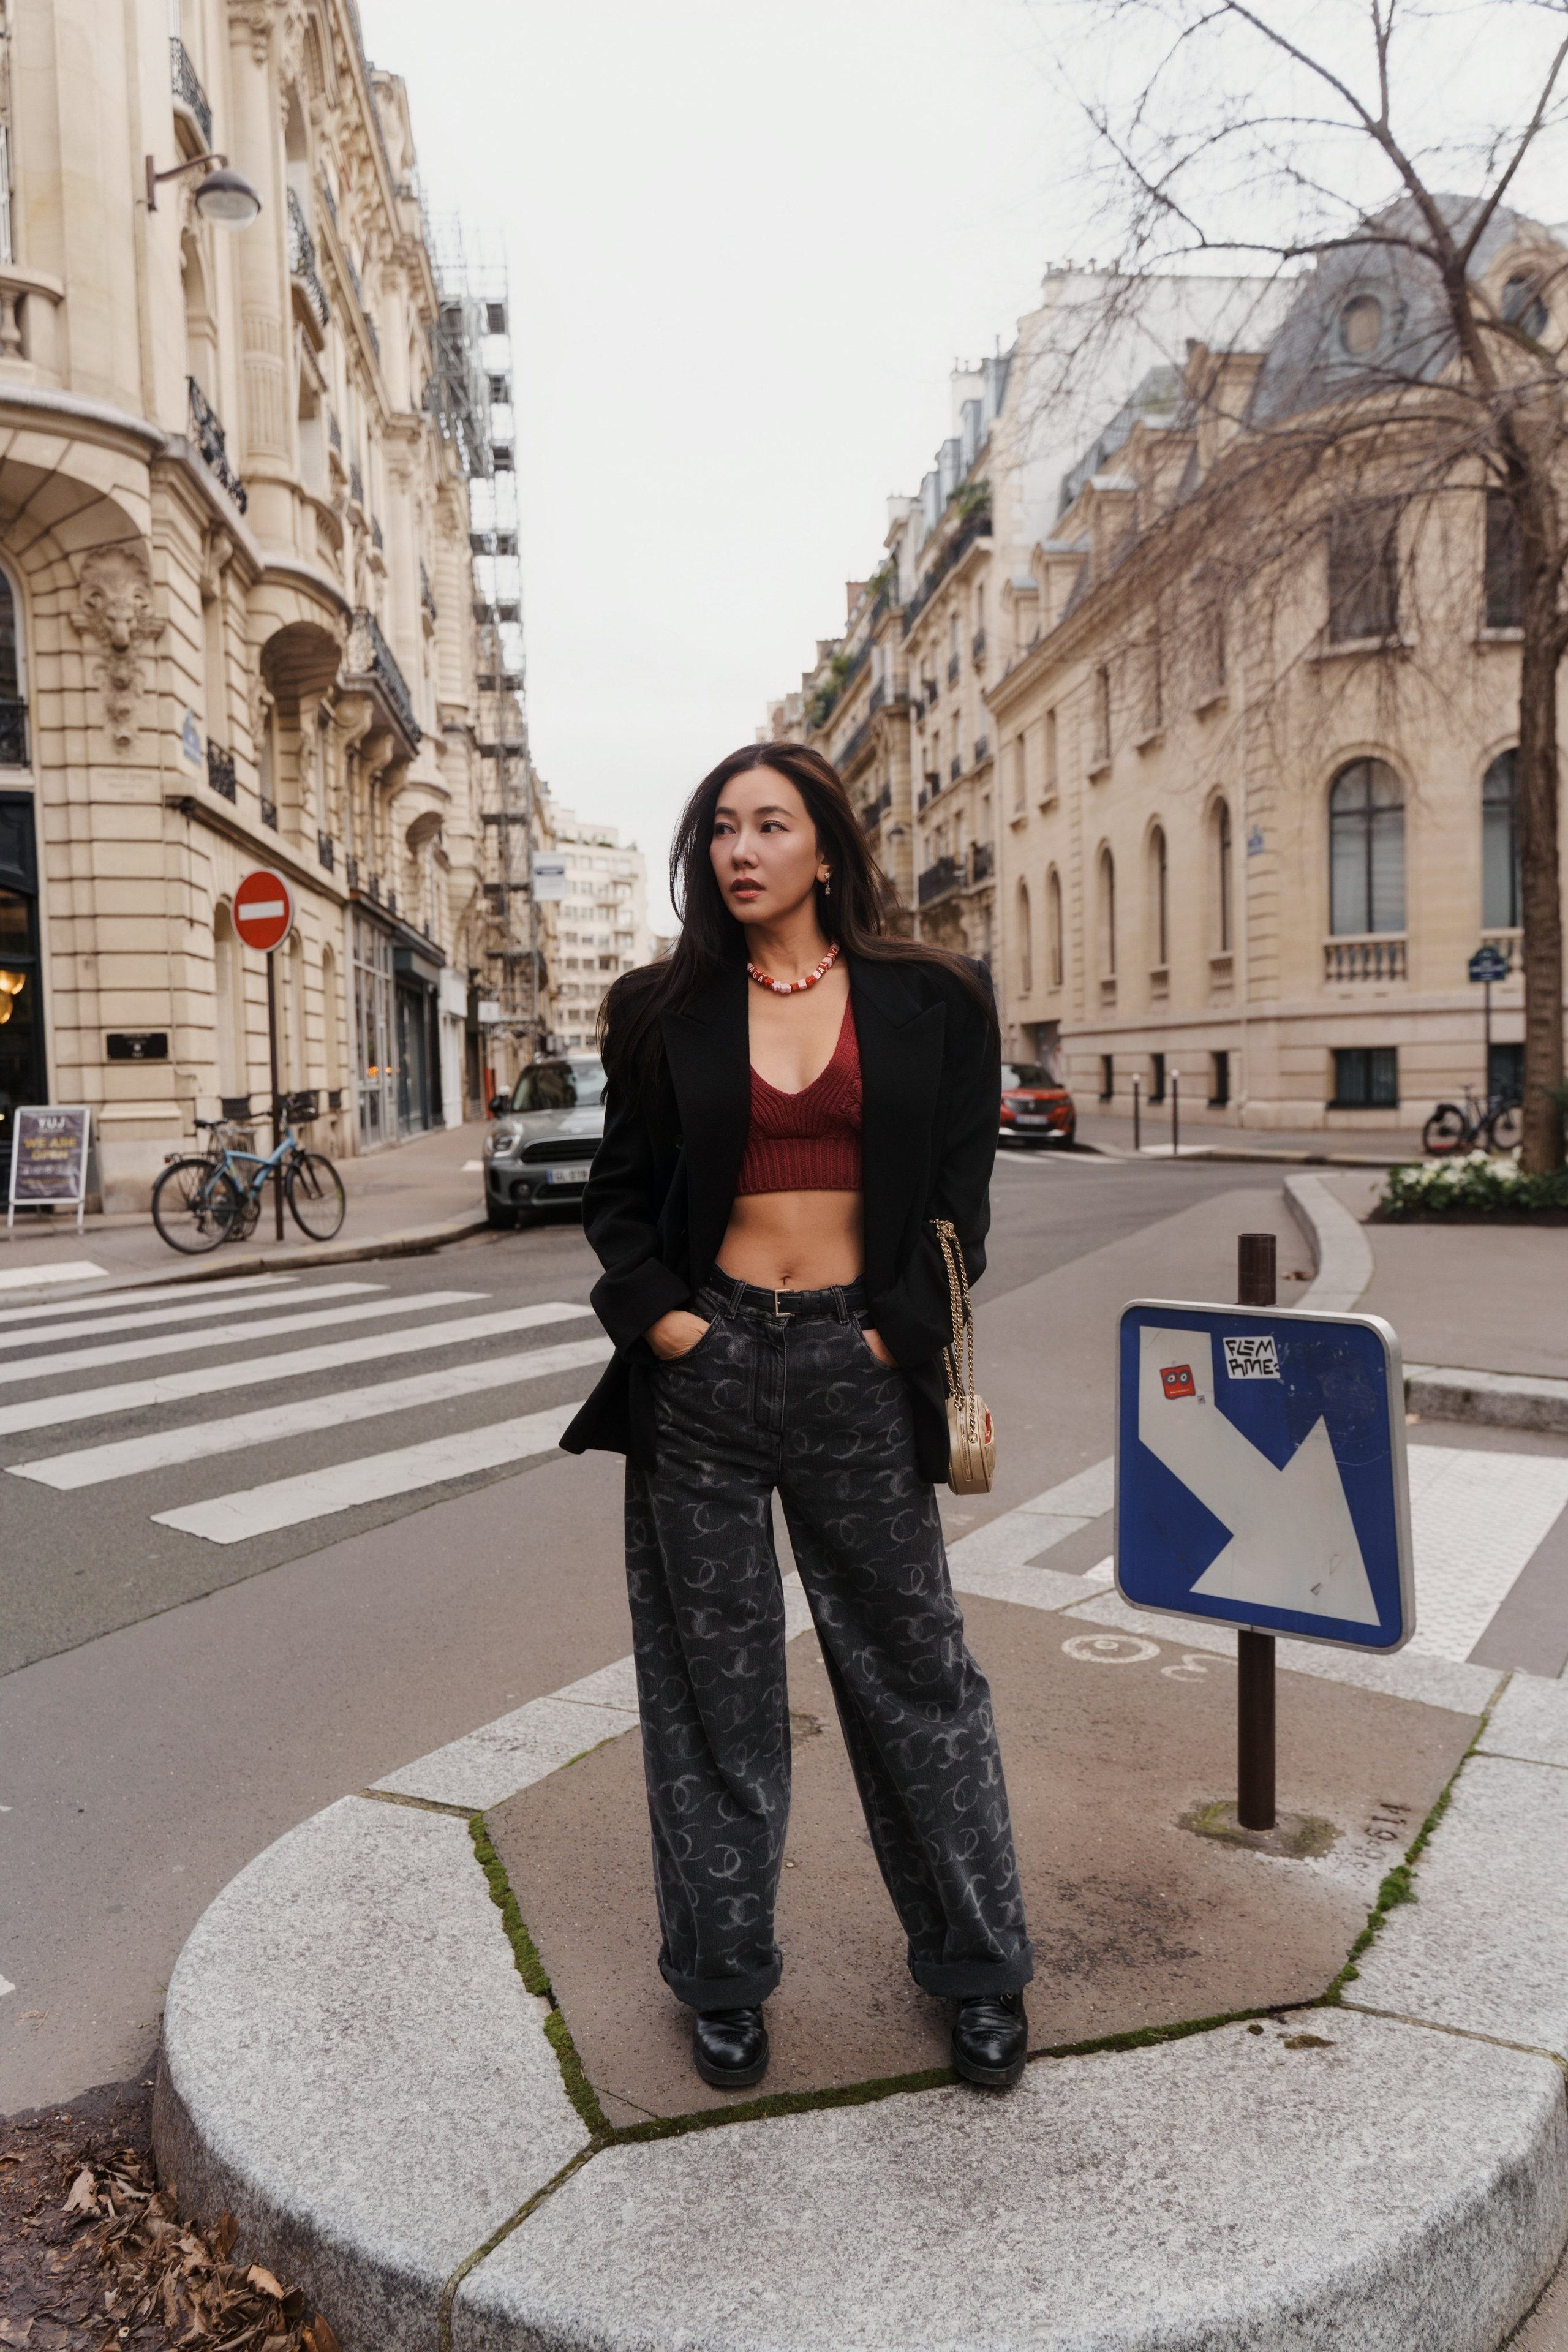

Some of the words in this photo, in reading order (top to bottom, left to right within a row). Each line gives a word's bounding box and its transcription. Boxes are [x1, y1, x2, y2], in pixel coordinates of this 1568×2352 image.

[38, 1117, 66, 1129] YUJ
[24, 1137, 47, 1149] WE
[49, 1136, 77, 1148] ARE
